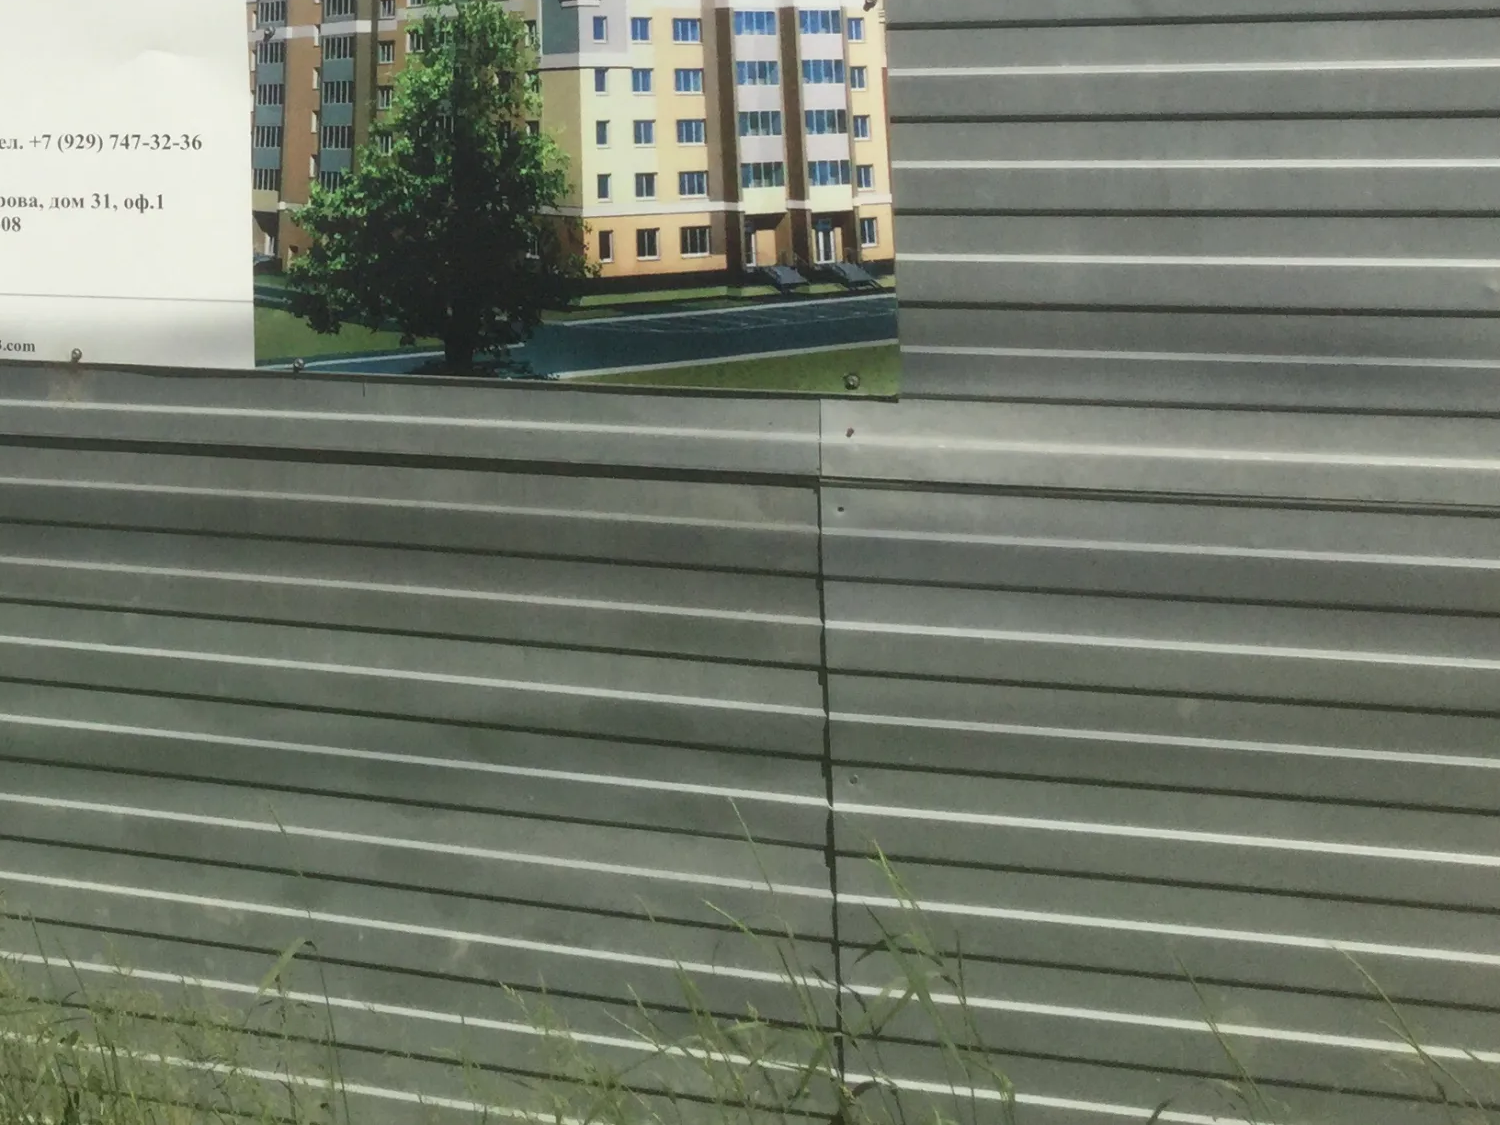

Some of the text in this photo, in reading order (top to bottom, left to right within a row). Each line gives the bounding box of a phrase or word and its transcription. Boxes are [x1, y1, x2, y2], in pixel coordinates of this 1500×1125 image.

[28, 133, 52, 150] +7
[57, 133, 104, 153] (929)
[108, 133, 203, 151] 747-32-36
[48, 196, 85, 210] дом
[90, 192, 118, 212] 31,
[123, 193, 164, 215] оф.1
